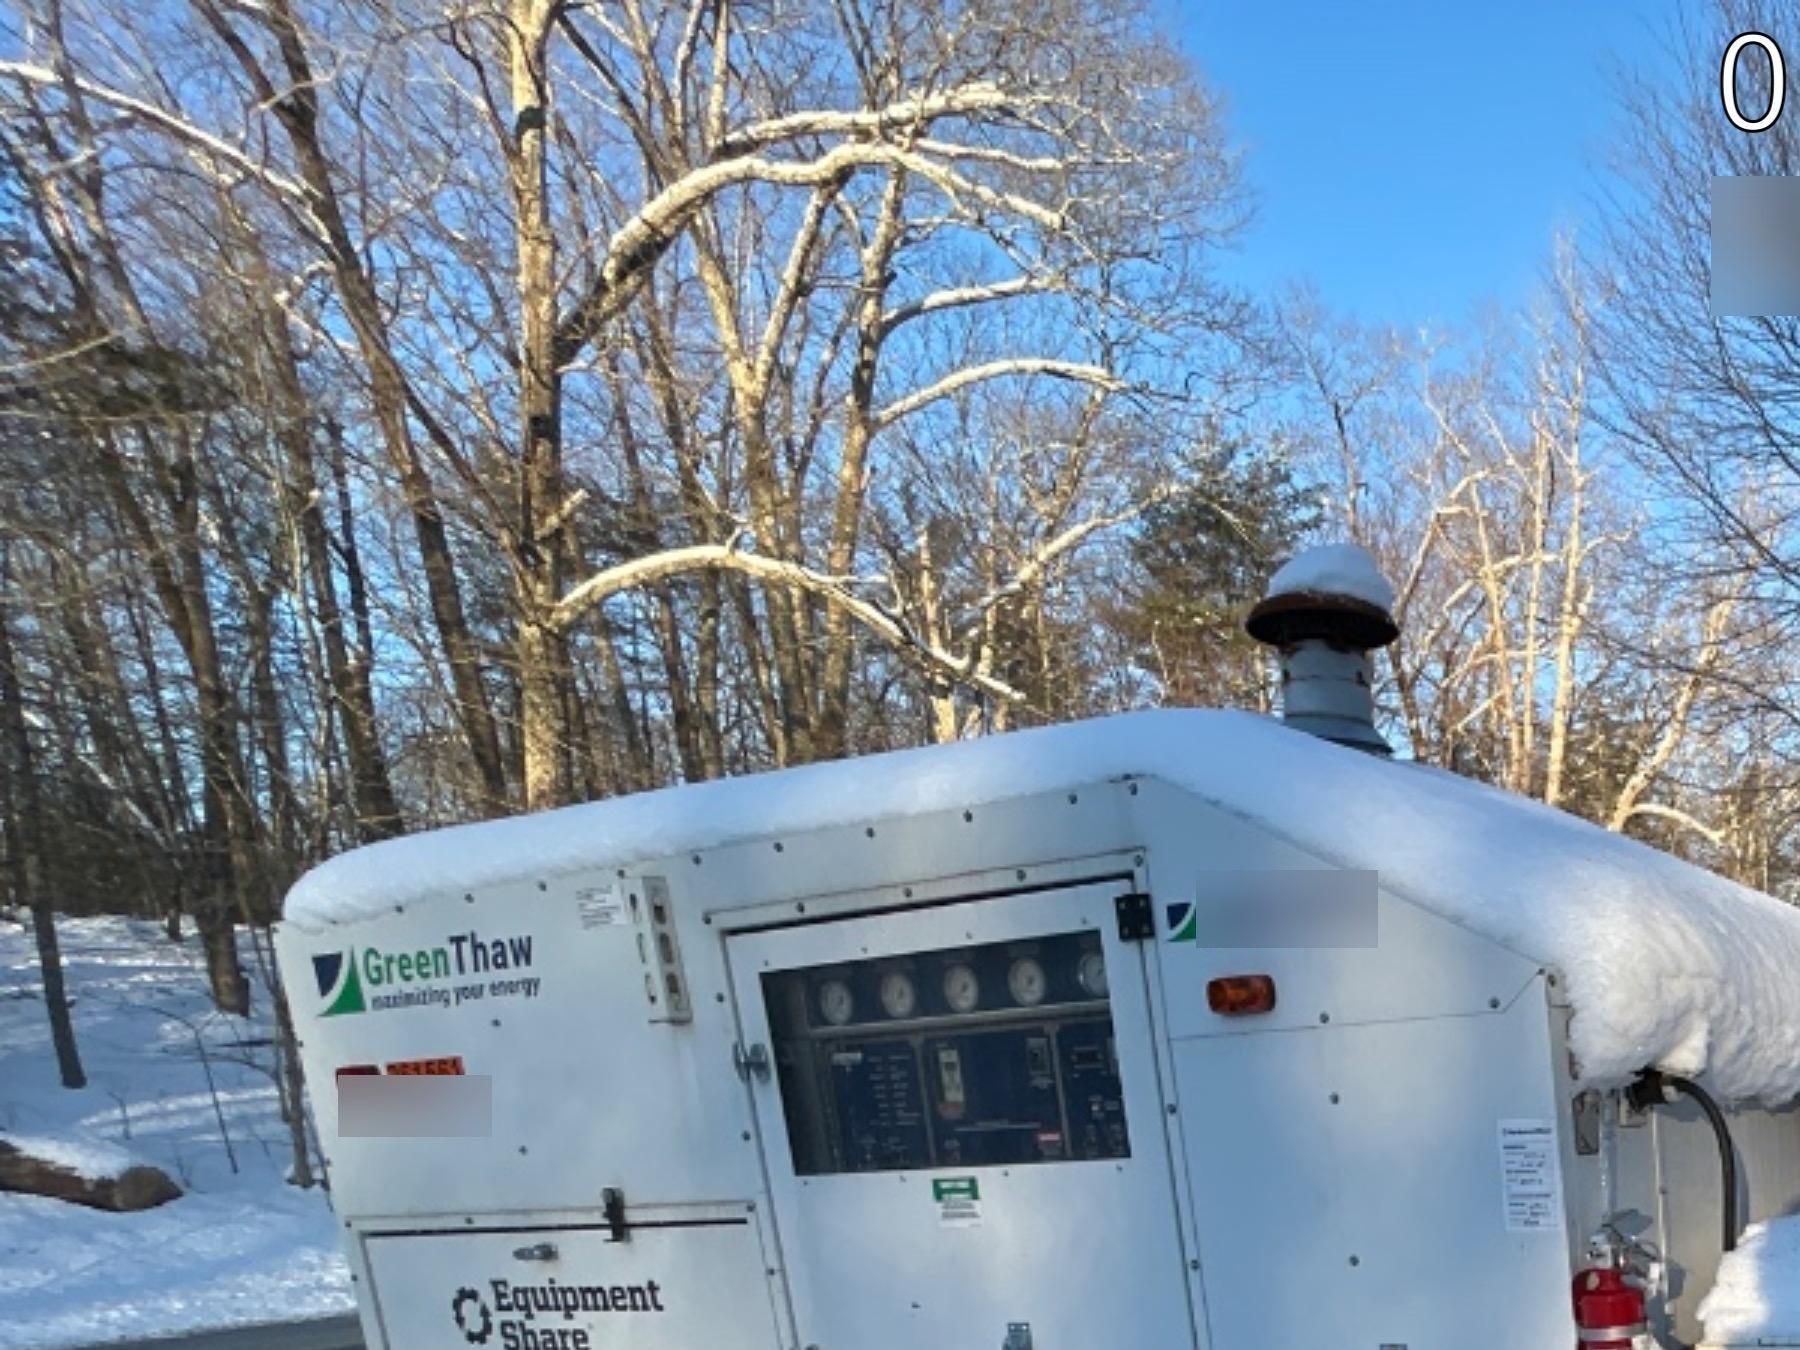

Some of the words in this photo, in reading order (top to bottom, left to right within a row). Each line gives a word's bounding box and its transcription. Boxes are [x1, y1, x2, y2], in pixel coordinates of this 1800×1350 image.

[363, 931, 533, 986] GreenThaw
[371, 984, 451, 1010] maximizing
[452, 983, 485, 1007] your
[489, 976, 542, 999] energy
[490, 1277, 664, 1320] Equipment
